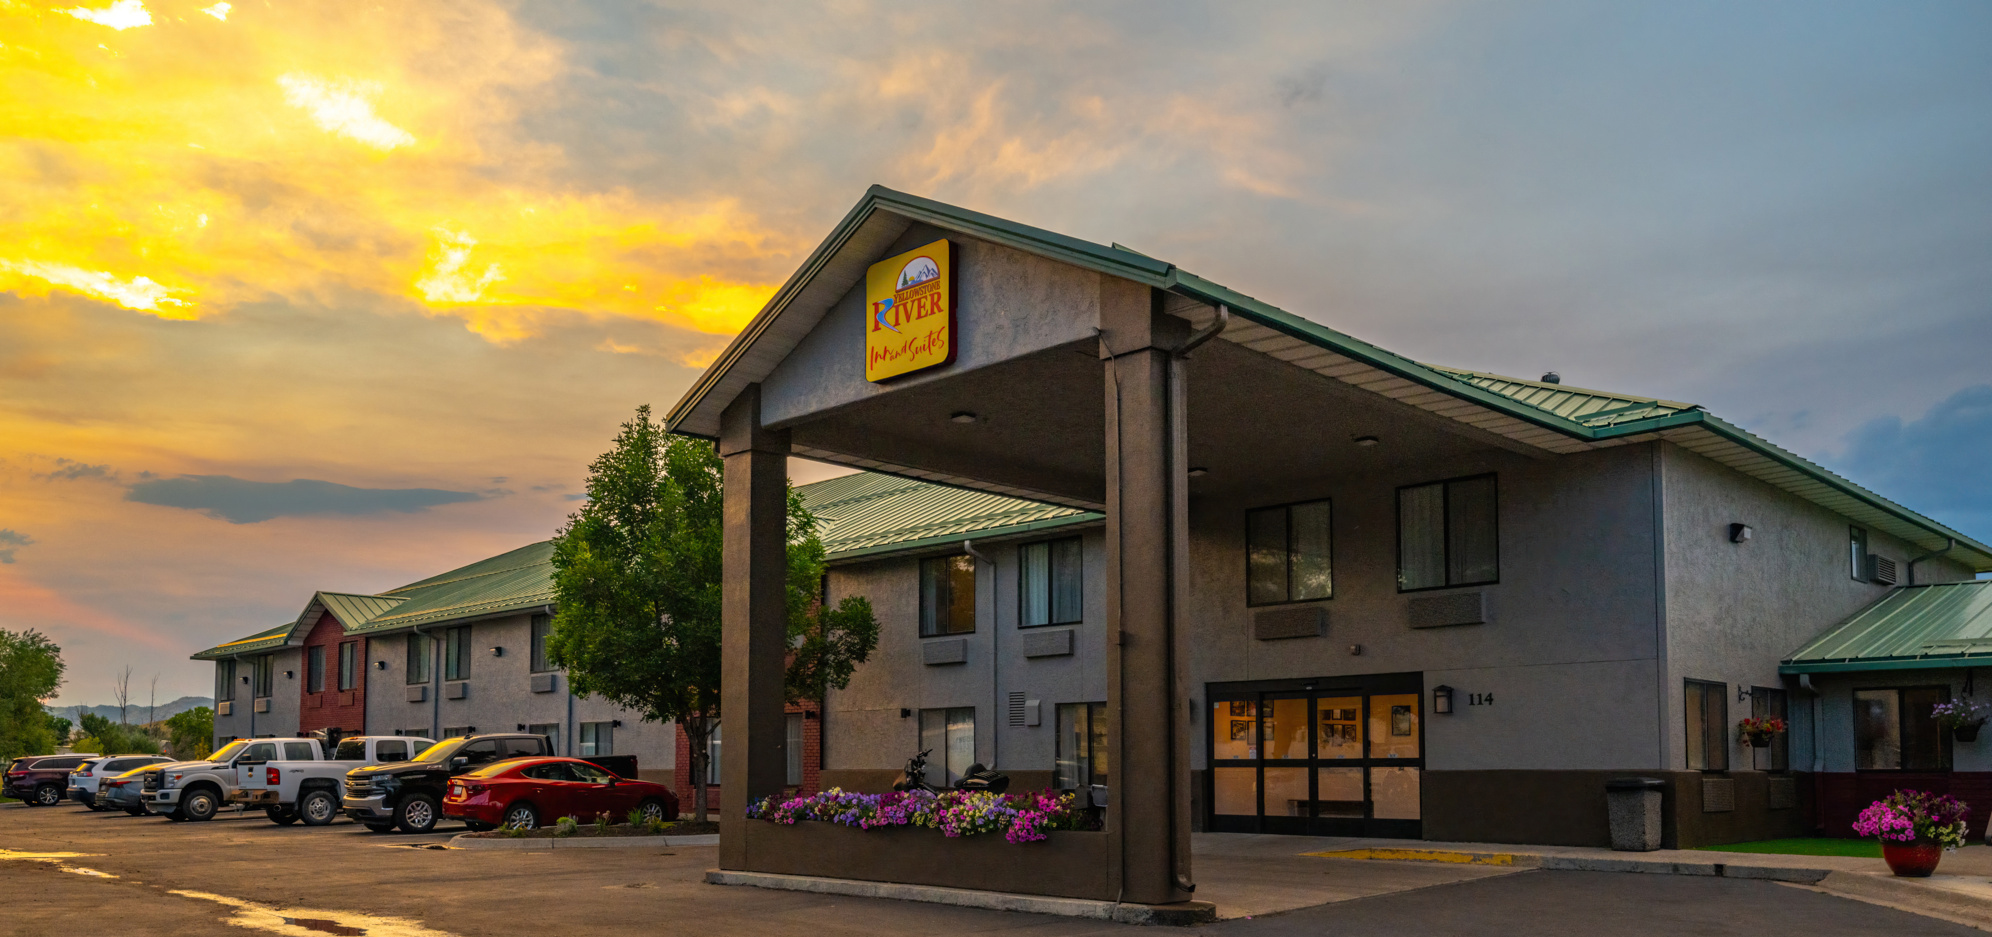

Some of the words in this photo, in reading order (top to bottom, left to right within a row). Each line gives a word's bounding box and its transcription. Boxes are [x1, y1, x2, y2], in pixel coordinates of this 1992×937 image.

[893, 280, 940, 304] YELLOWSTONE
[872, 291, 944, 334] RIVER
[889, 340, 907, 361] and
[1468, 692, 1494, 706] 114
